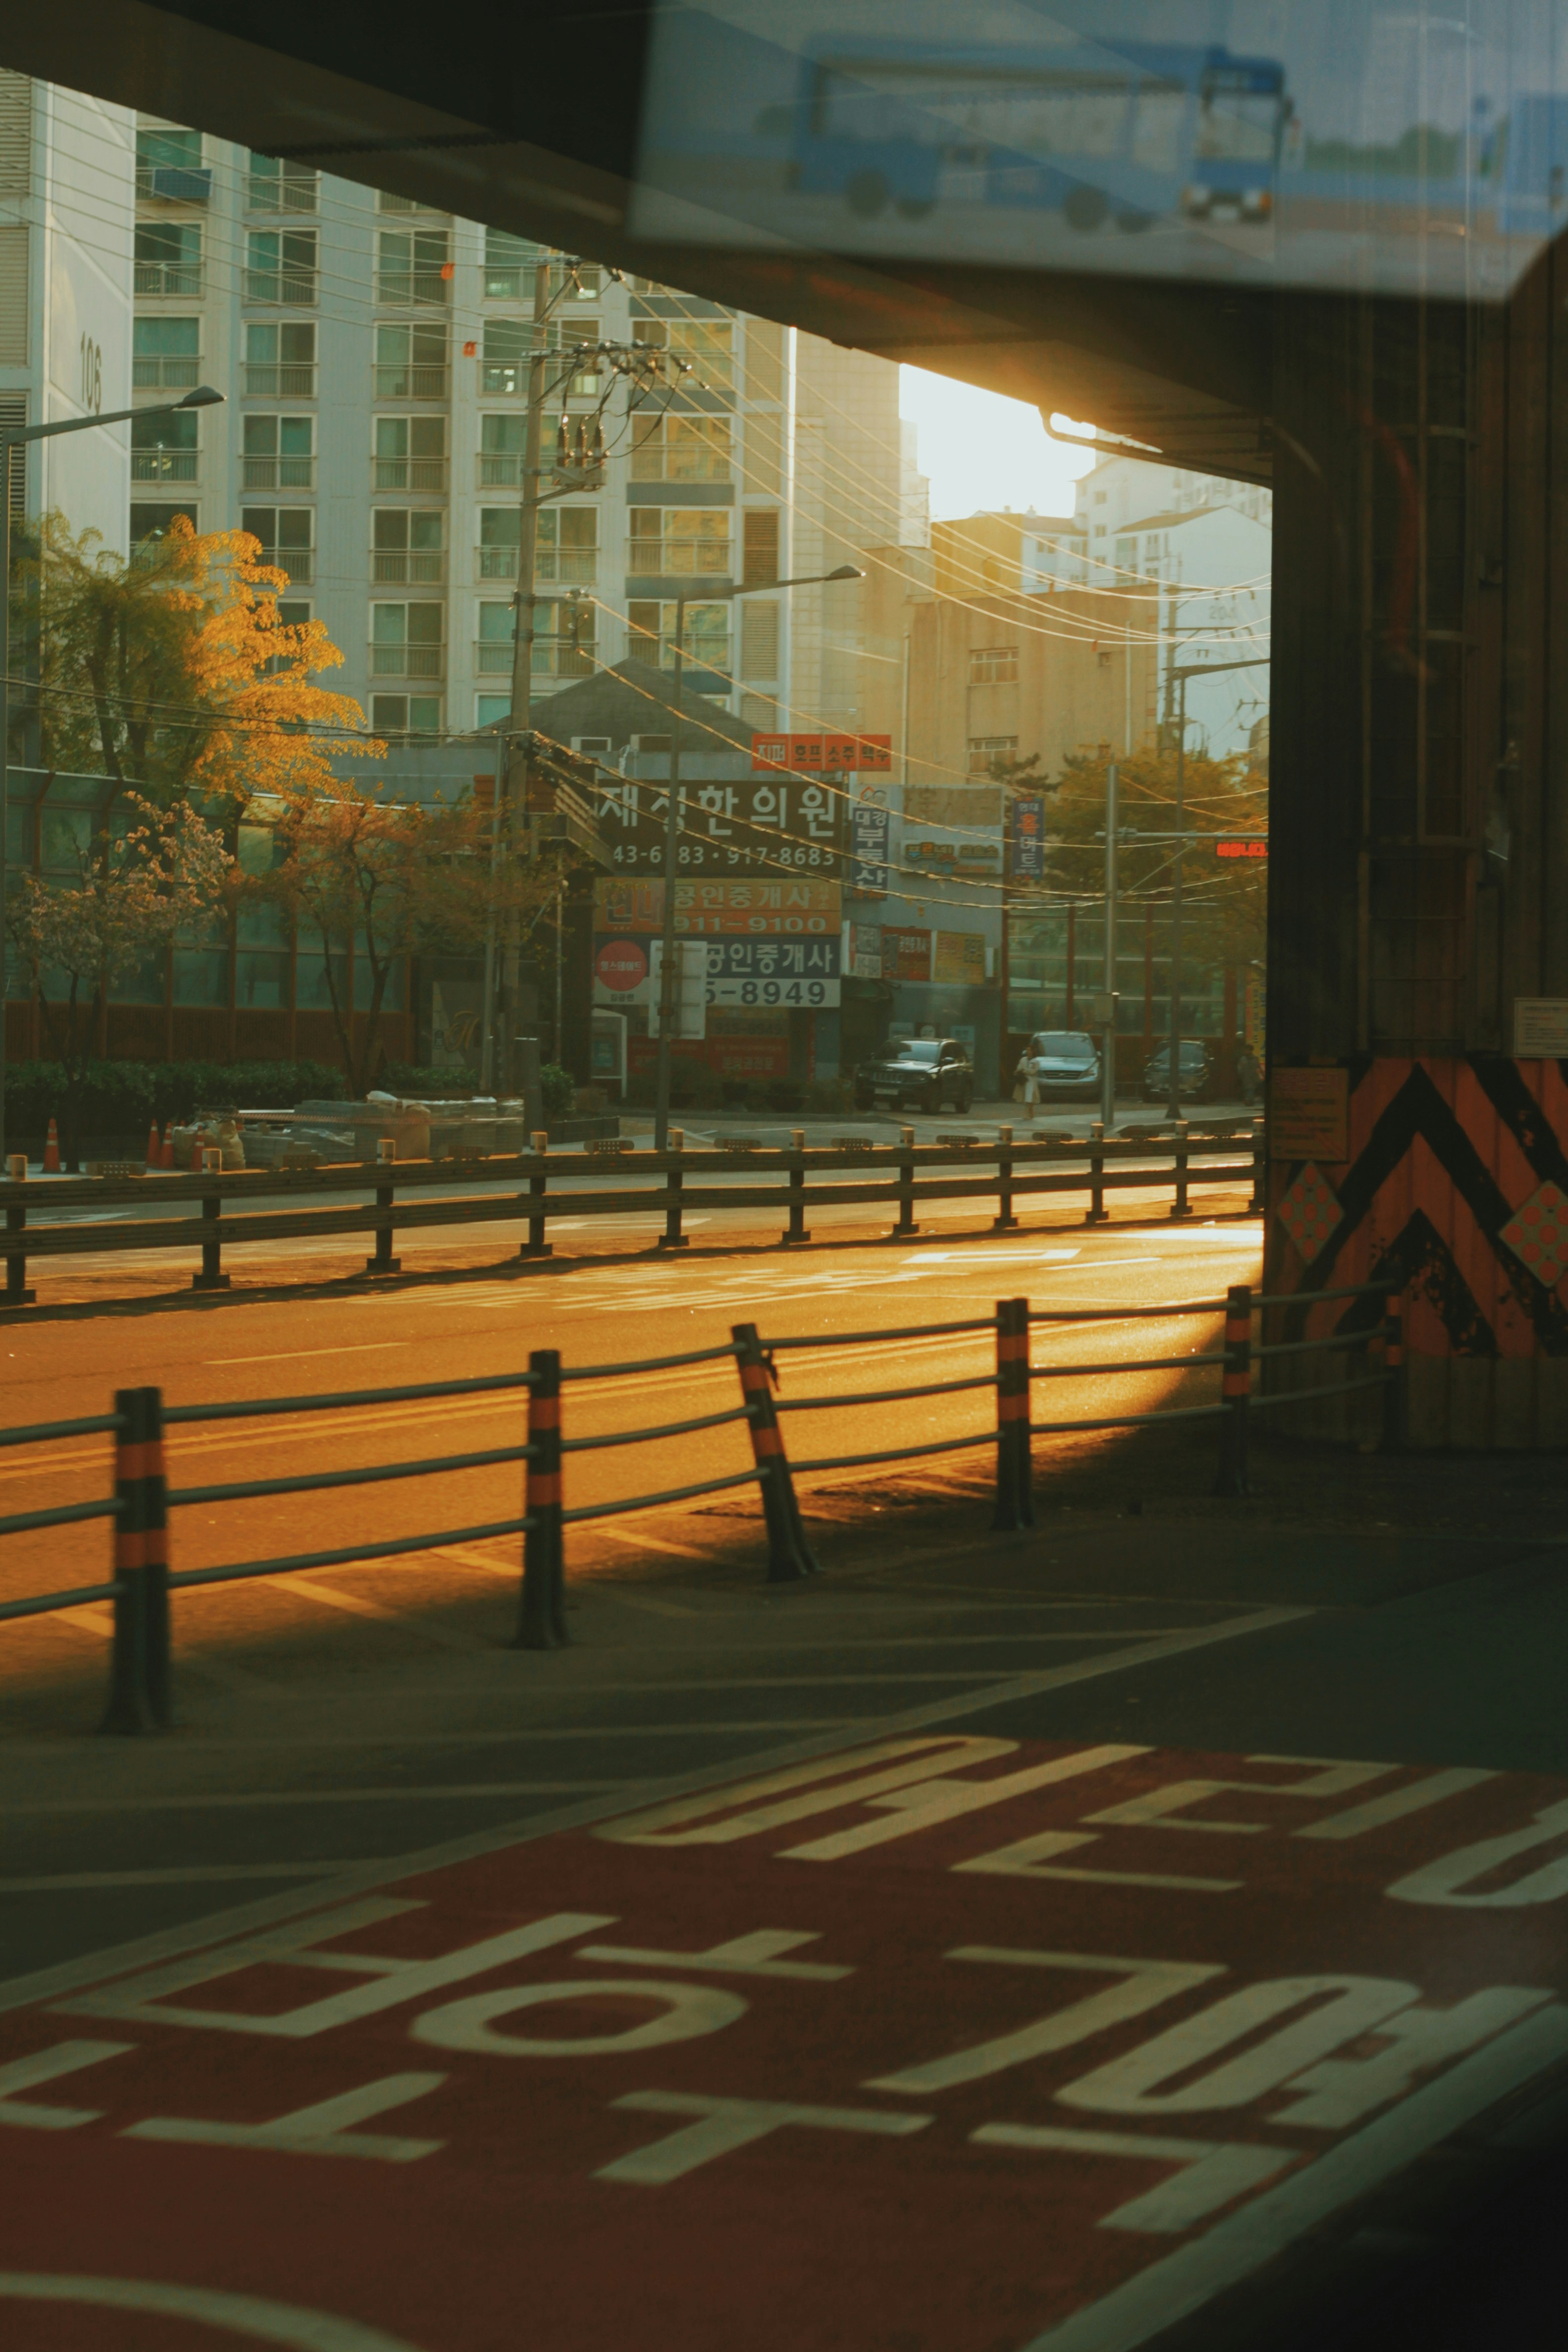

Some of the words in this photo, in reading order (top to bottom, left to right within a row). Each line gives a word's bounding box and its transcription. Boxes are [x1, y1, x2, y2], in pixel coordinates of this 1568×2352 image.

[81, 331, 101, 416] 106
[794, 745, 822, 762] 호프
[828, 745, 855, 762] 소주
[862, 745, 889, 762] 맥주
[856, 811, 887, 827] 대경
[613, 845, 704, 864] 43-683
[855, 828, 886, 889] 부동산
[675, 884, 812, 909] 공인중개사
[674, 916, 827, 931] 911-9100
[601, 961, 642, 971] 힐스테이트
[707, 943, 833, 975] 공인중개사
